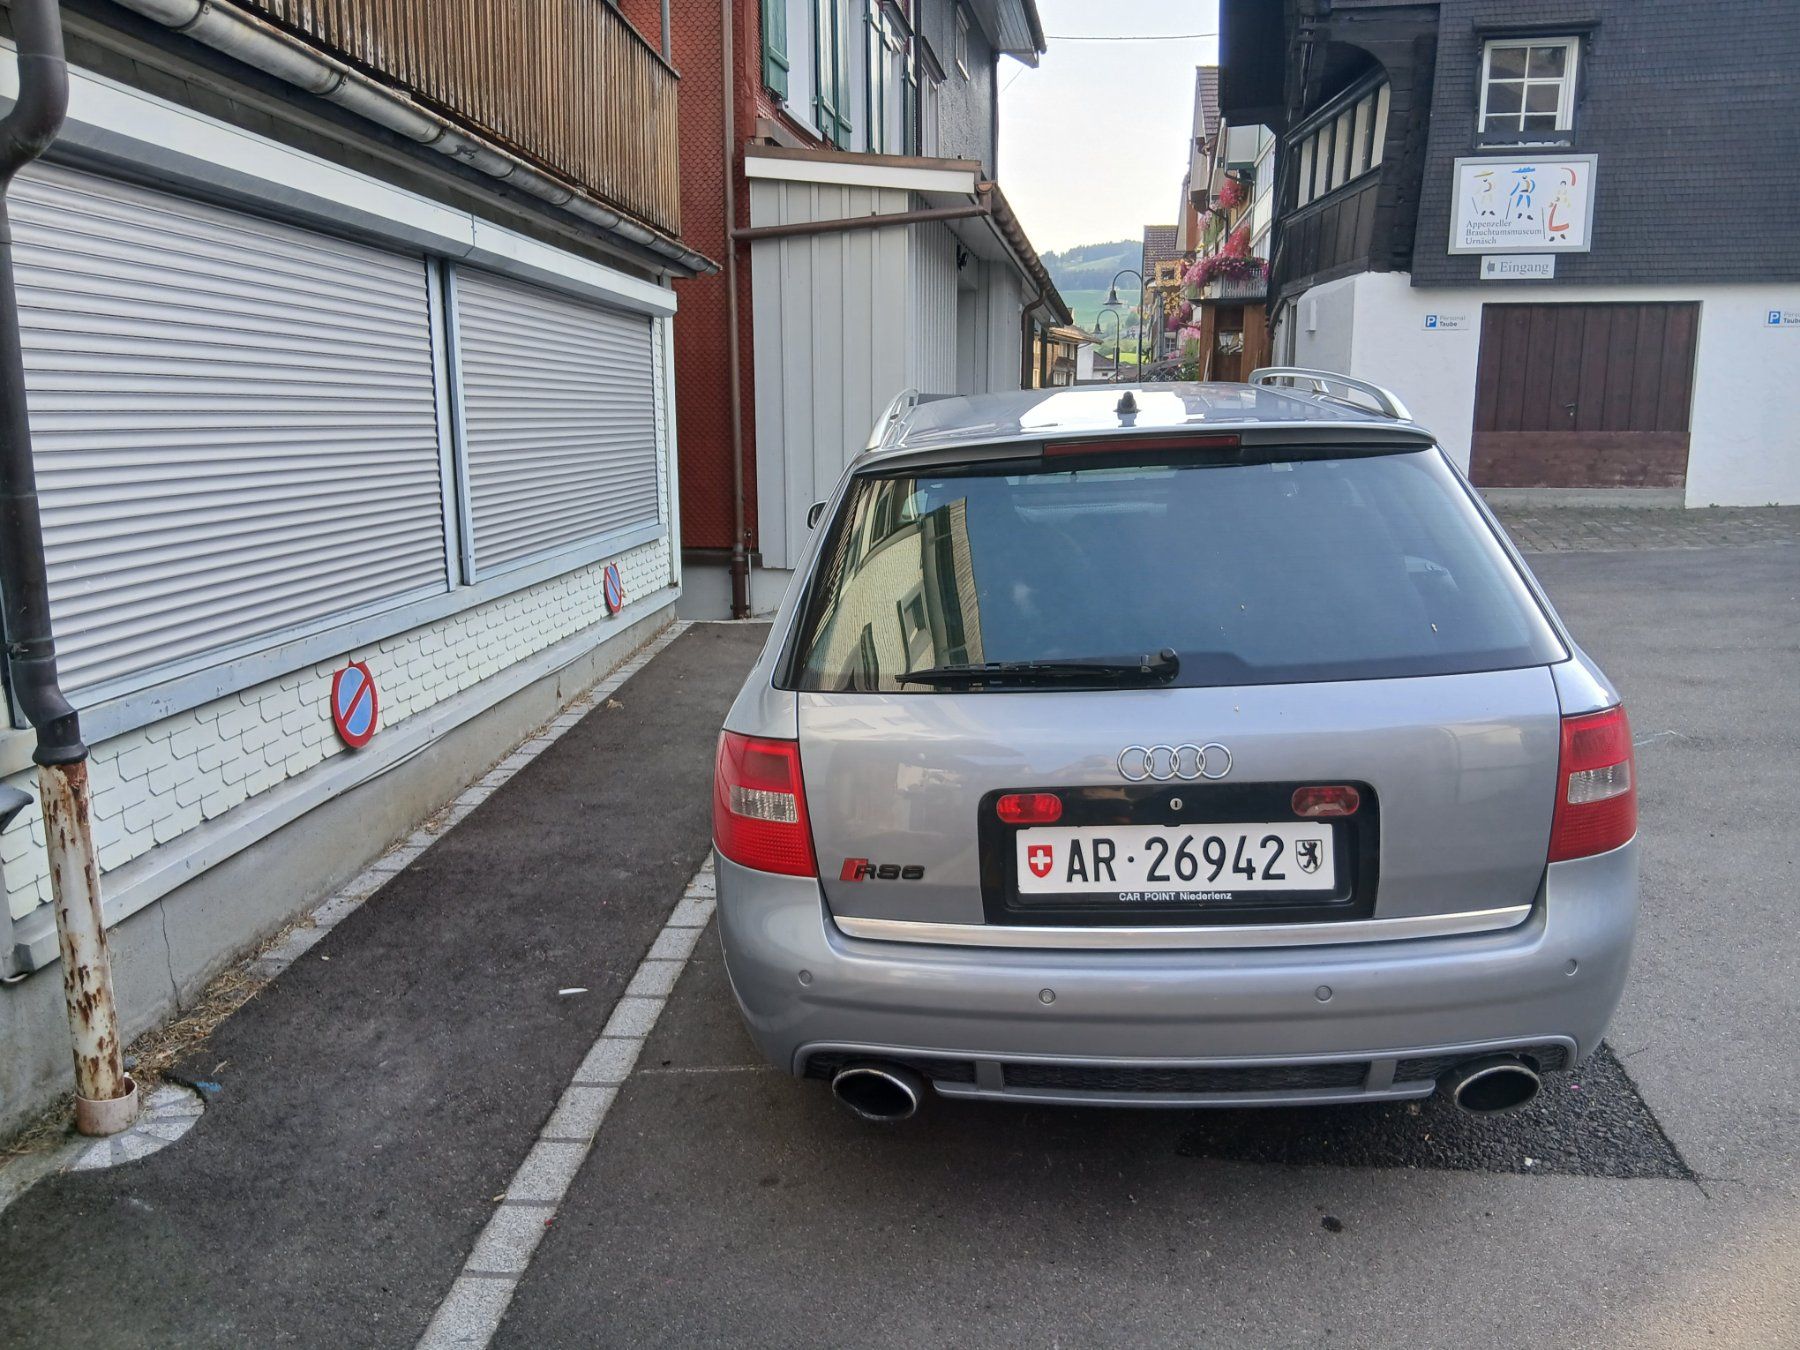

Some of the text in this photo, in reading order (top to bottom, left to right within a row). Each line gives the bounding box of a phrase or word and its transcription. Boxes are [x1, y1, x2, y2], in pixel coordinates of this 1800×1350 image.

[1466, 219, 1512, 230] Appenzeller
[1466, 228, 1542, 237] Brauchtumsmuseum
[1465, 237, 1497, 245] Urnäsch
[1500, 261, 1549, 275] Eingang
[1426, 316, 1436, 327] P
[1769, 312, 1779, 323] P
[1119, 891, 1233, 901] CAR POINT Niederlenz
